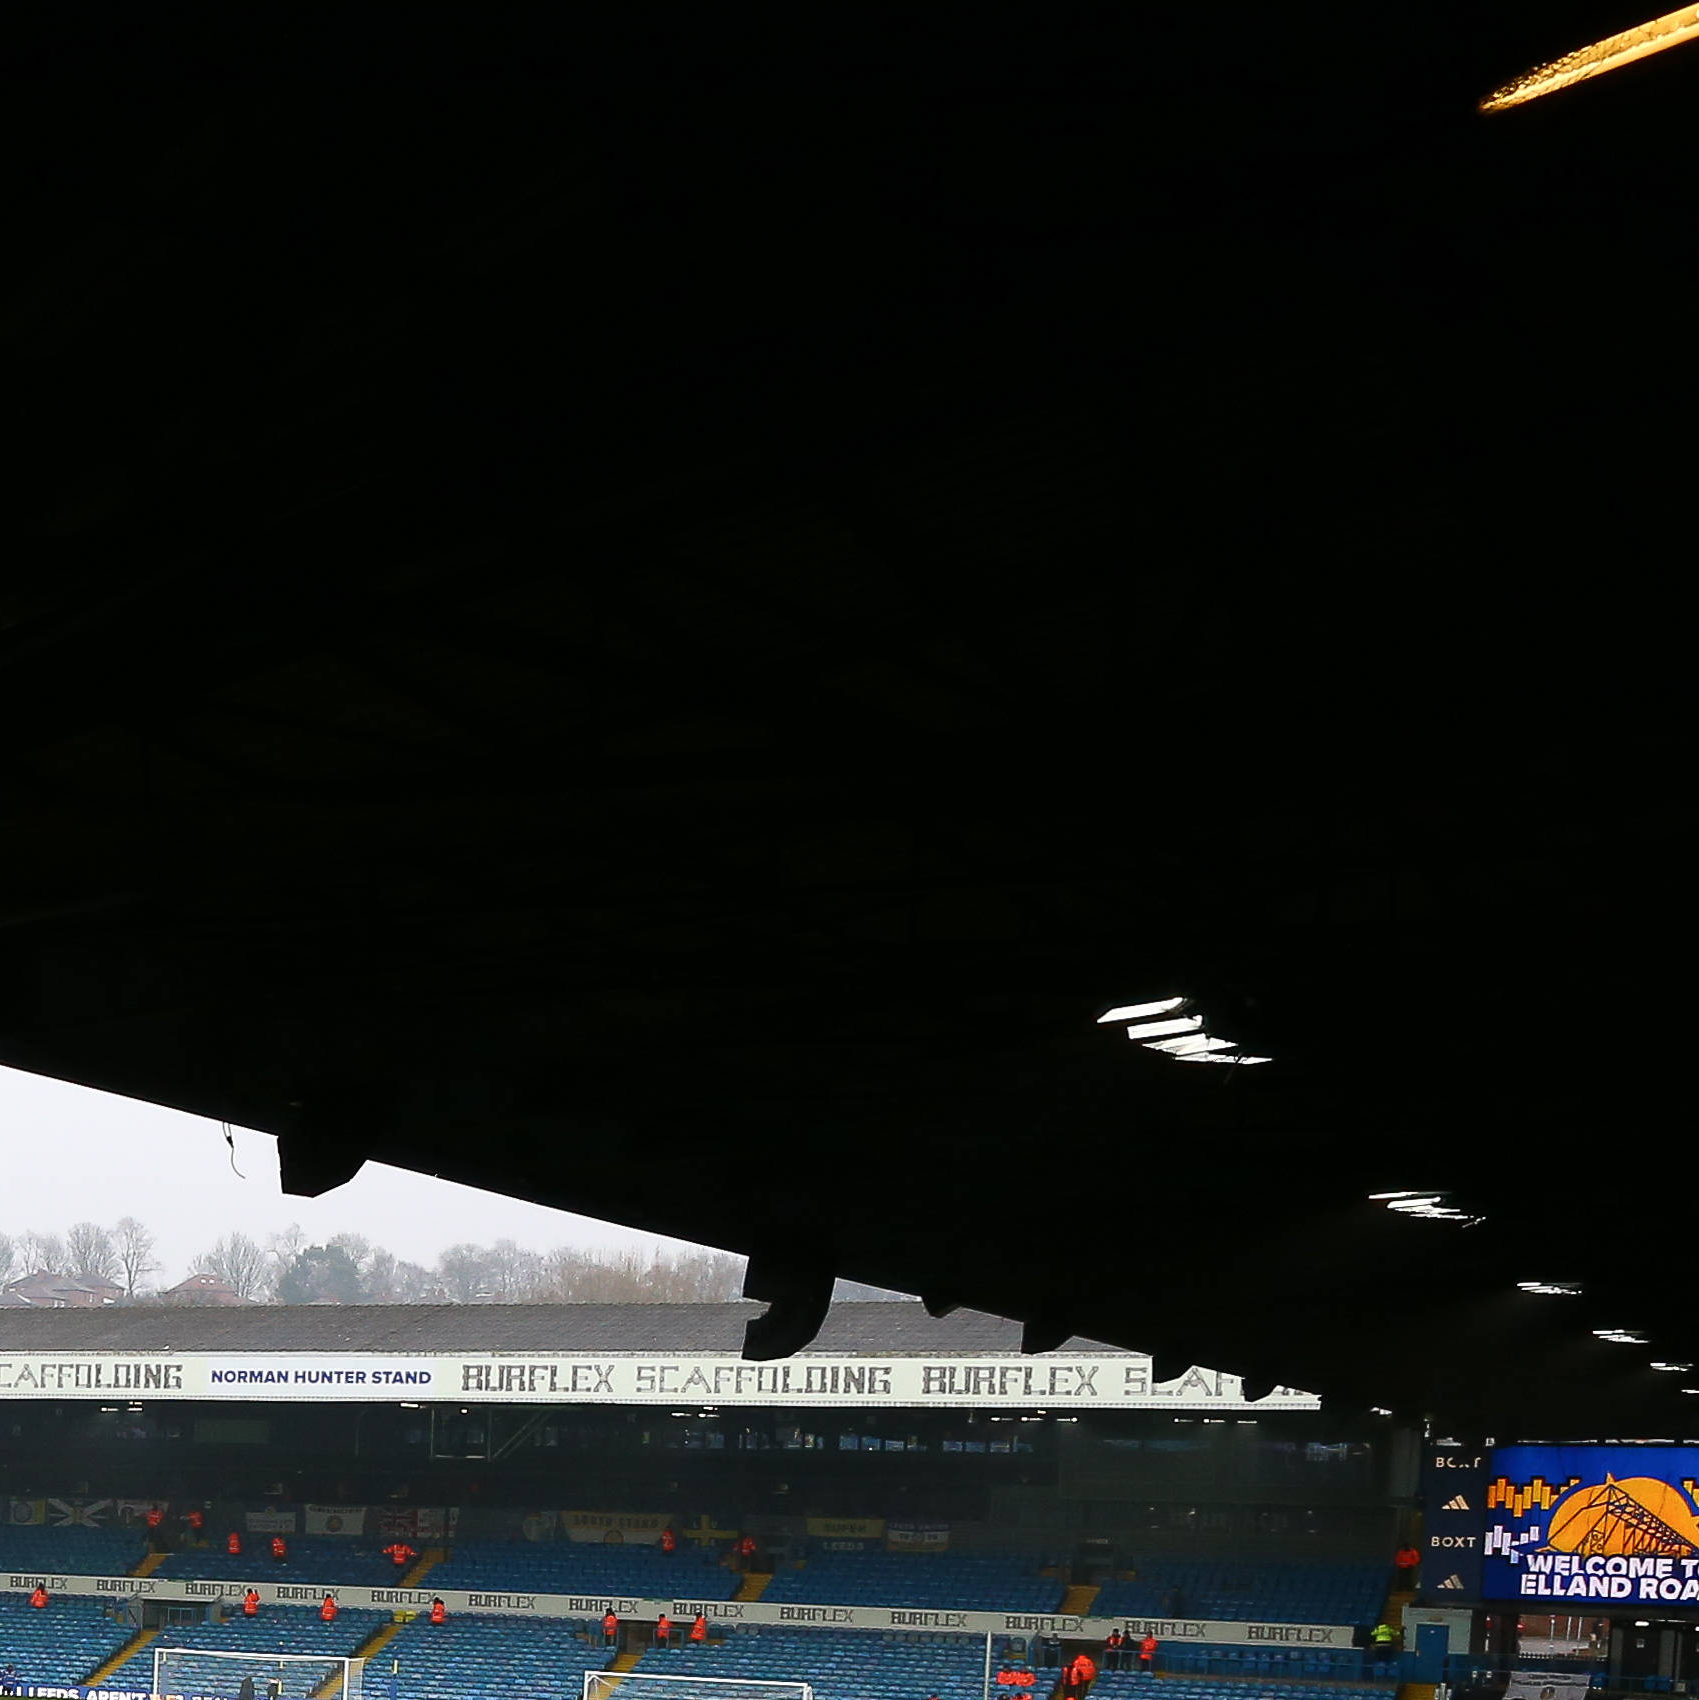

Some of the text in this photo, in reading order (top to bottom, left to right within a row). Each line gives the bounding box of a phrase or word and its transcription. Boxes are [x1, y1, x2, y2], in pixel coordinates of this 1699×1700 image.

[211, 1370, 431, 1384] NORMAN HUNTER STAND
[461, 1363, 615, 1392] BURFLEX
[636, 1366, 891, 1395] SCAFFOLDING
[922, 1365, 1097, 1397] BURFLEX
[1431, 1537, 1476, 1548] BOXT
[1526, 1554, 1699, 1578] WELCOME T
[1521, 1574, 1632, 1598] ELLAND
